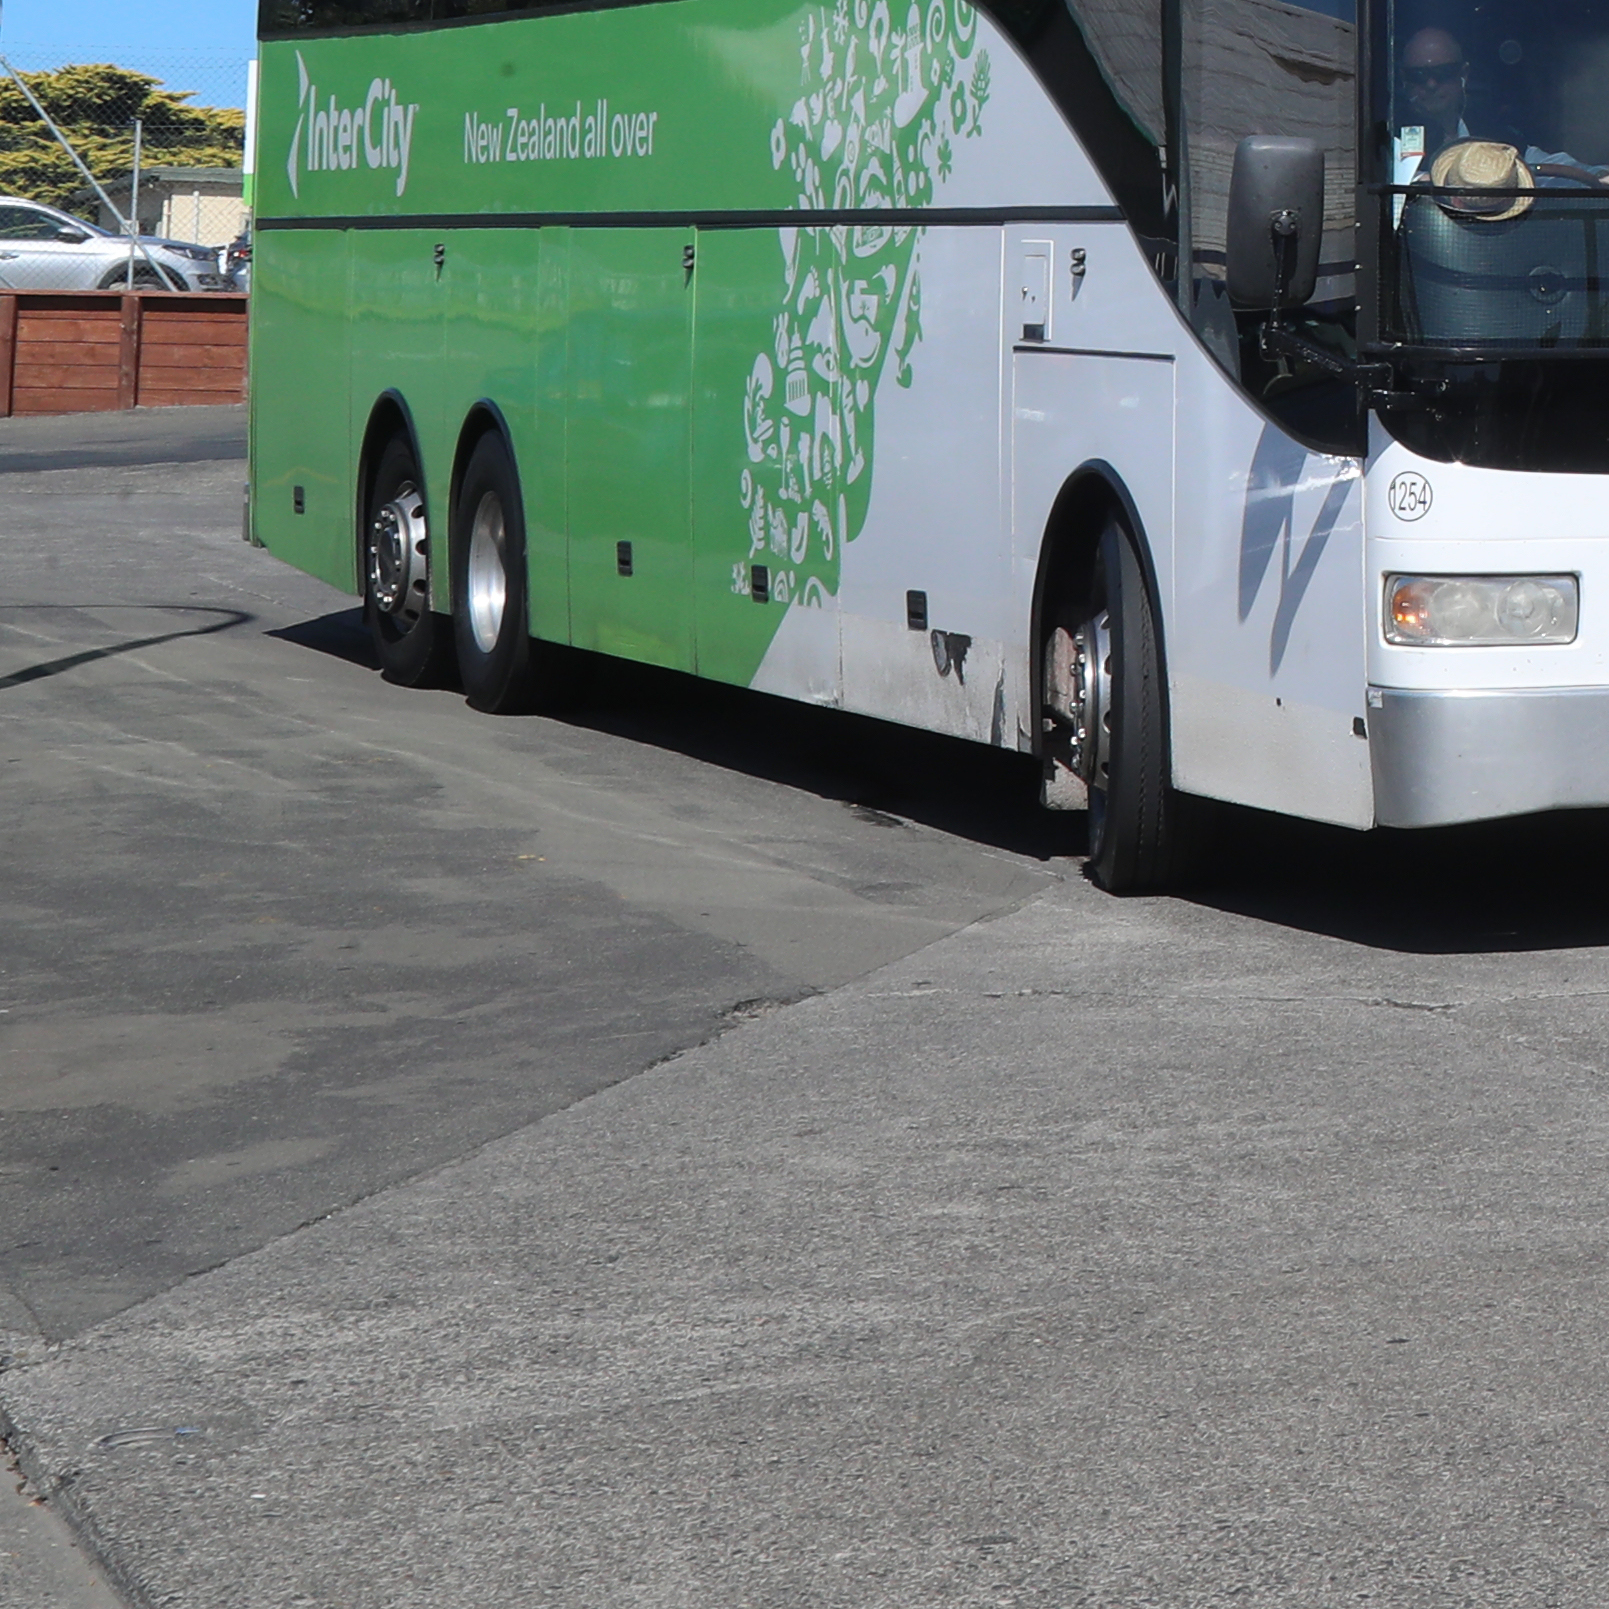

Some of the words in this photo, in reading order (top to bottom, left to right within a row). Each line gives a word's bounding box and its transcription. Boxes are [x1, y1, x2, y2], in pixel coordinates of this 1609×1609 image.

[307, 77, 417, 197] InterCity
[464, 111, 503, 163] New
[505, 100, 581, 162] Zealand
[584, 98, 607, 158] all
[611, 111, 658, 158] over
[1390, 479, 1427, 511] 1254
